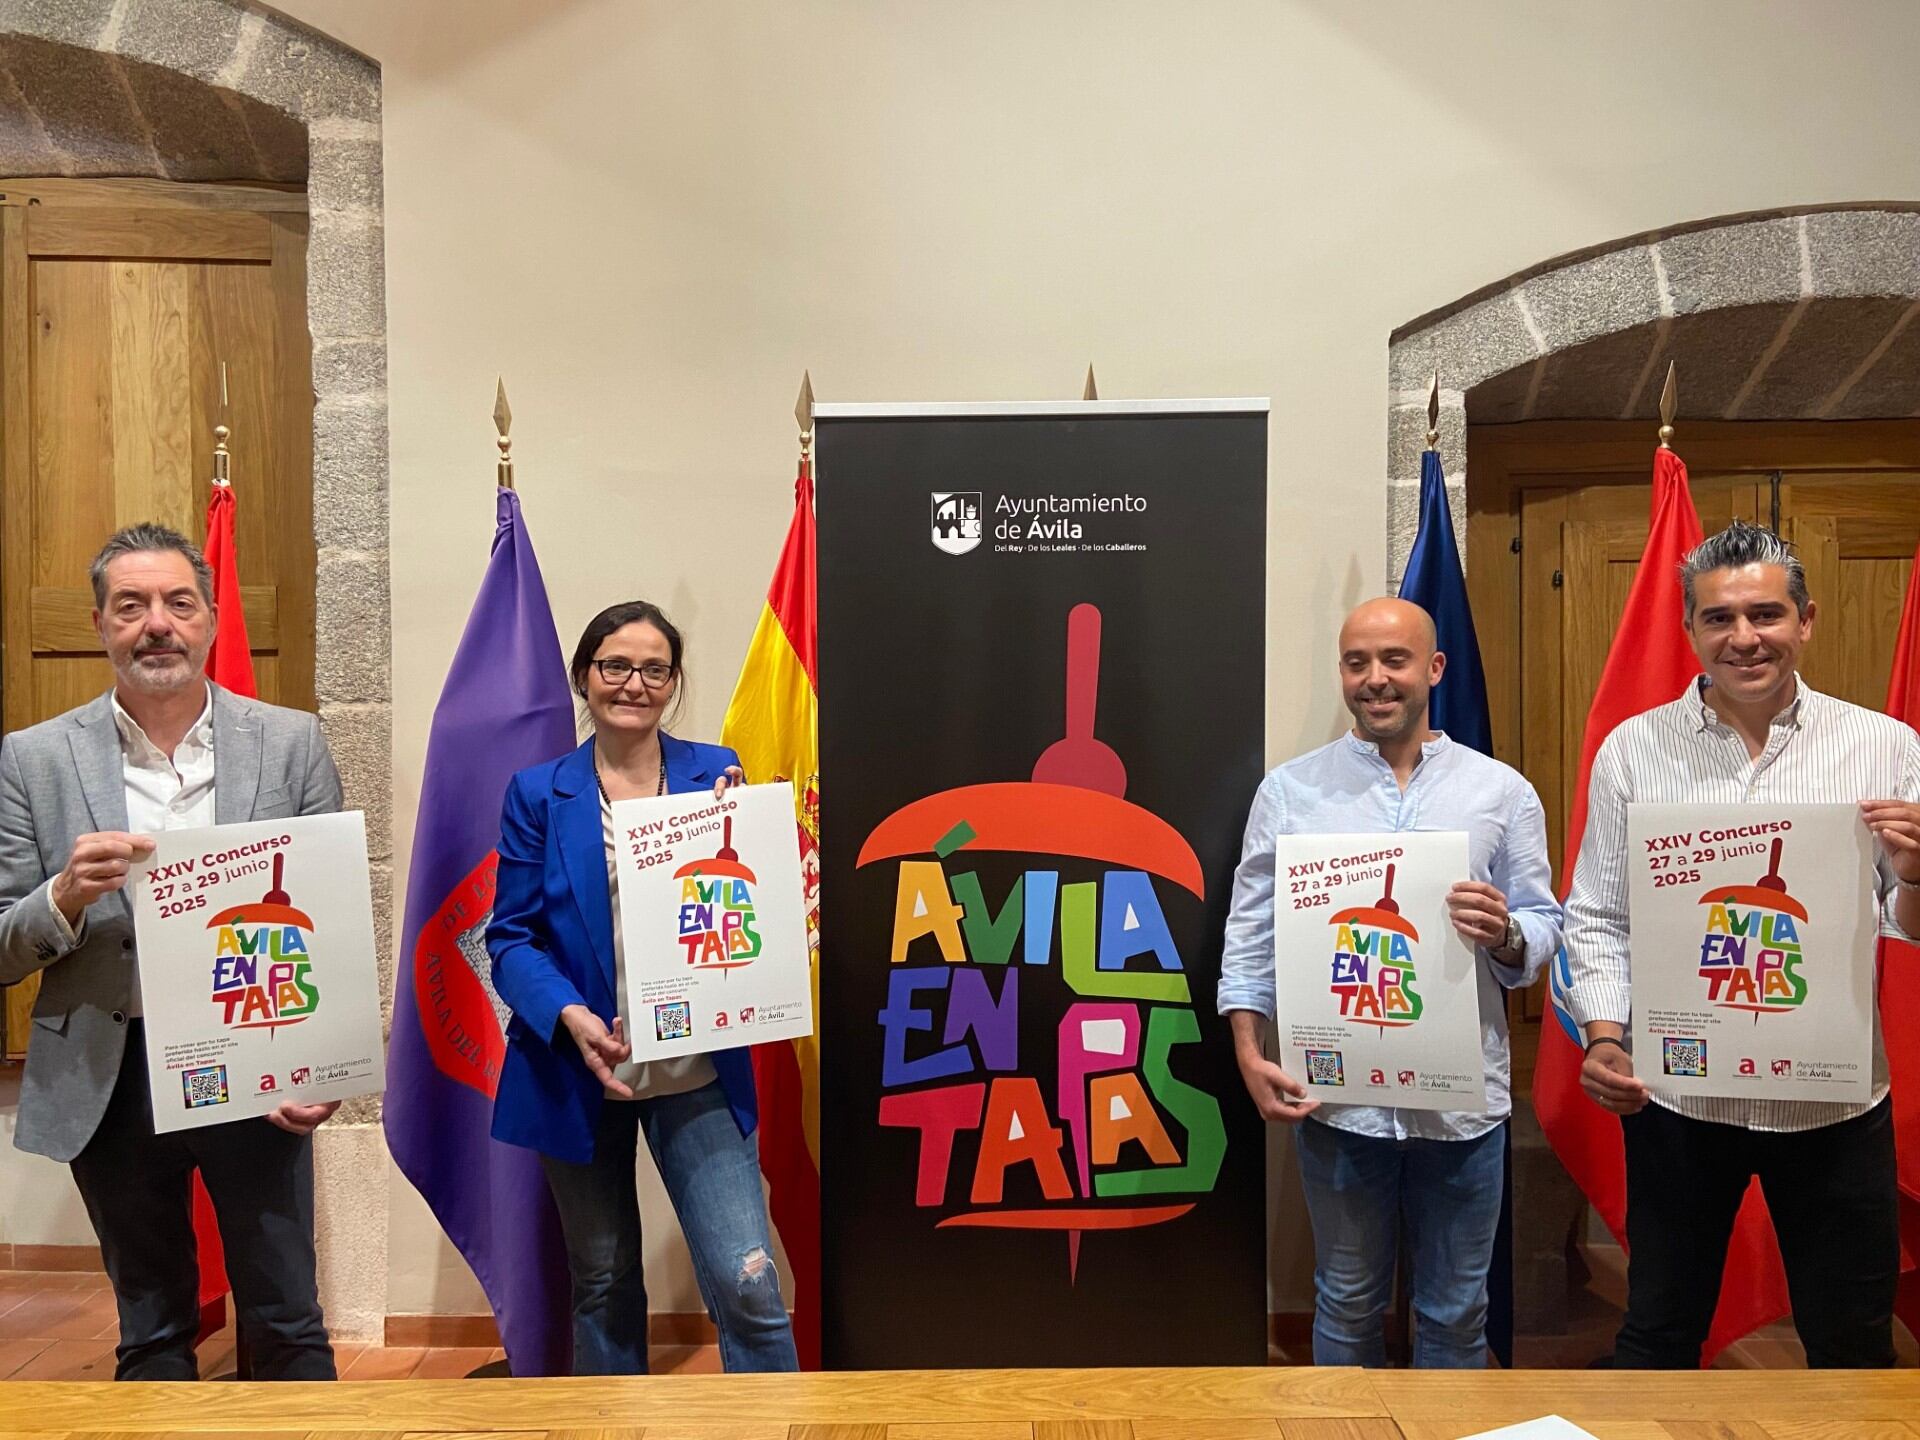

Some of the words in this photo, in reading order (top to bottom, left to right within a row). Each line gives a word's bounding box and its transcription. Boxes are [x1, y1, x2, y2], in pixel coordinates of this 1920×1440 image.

[995, 494, 1147, 517] Ayuntamiento
[995, 520, 1021, 539] de
[1027, 514, 1082, 539] Ávila
[995, 544, 1008, 552] Del
[1009, 545, 1023, 553] Rey
[1028, 544, 1038, 552] De
[1040, 544, 1050, 552] los
[1094, 543, 1104, 551] los
[1105, 543, 1146, 551] Caballeros
[627, 821, 664, 840] XXIV
[669, 799, 737, 828] Concurso
[632, 842, 649, 855] 27
[654, 839, 661, 848] a
[665, 832, 683, 845] 29
[686, 821, 720, 840] junio
[1645, 833, 1692, 852] XXIV
[1699, 819, 1792, 844] Concurso
[147, 859, 195, 884] XXIV
[202, 833, 291, 867] Concurso
[637, 850, 673, 870] 2025
[1288, 861, 1325, 878] XXIV
[1330, 846, 1403, 869] Concurso
[1649, 855, 1671, 869] 27
[1677, 855, 1688, 866] a
[1693, 849, 1715, 863] 29
[1721, 841, 1766, 861] junio
[152, 884, 174, 901] 27
[182, 881, 192, 892] a
[198, 873, 220, 888] 29
[225, 859, 269, 882] junio
[682, 869, 753, 911] ÁVILA
[1291, 880, 1307, 893] 27
[1312, 880, 1320, 889] a
[1324, 874, 1342, 887] 29
[1346, 868, 1383, 885] junio
[1654, 869, 1701, 887] 2025
[159, 894, 207, 919] 2025
[442, 902, 469, 930] DE
[891, 820, 1192, 1002] ÁVILA
[1294, 893, 1330, 910] 2025
[679, 904, 712, 934] EN
[1706, 896, 1800, 952] ÁVILA
[216, 914, 309, 962] ÁVILA
[679, 912, 762, 964] TAPAS
[1335, 917, 1414, 970] ÁVILA
[1701, 935, 1746, 966] EN
[212, 955, 257, 991] EN
[1331, 953, 1369, 983] EN
[1698, 949, 1809, 1004] TAPAS
[212, 963, 319, 1024] TAPAS
[759, 1002, 802, 1013] Ayuntamiento
[1331, 968, 1423, 1020] TAPAS
[768, 1011, 784, 1019] Ávila
[878, 967, 1018, 1086] EN
[315, 1057, 371, 1072] Ayuntamiento
[327, 1069, 348, 1079] Ávila
[1420, 1072, 1472, 1082] Ayuntamiento
[1796, 1061, 1857, 1070] Ayuntamiento
[1809, 1070, 1831, 1078] Ávila
[1431, 1080, 1450, 1088] Ávila
[879, 1003, 1228, 1206] TAPAS
